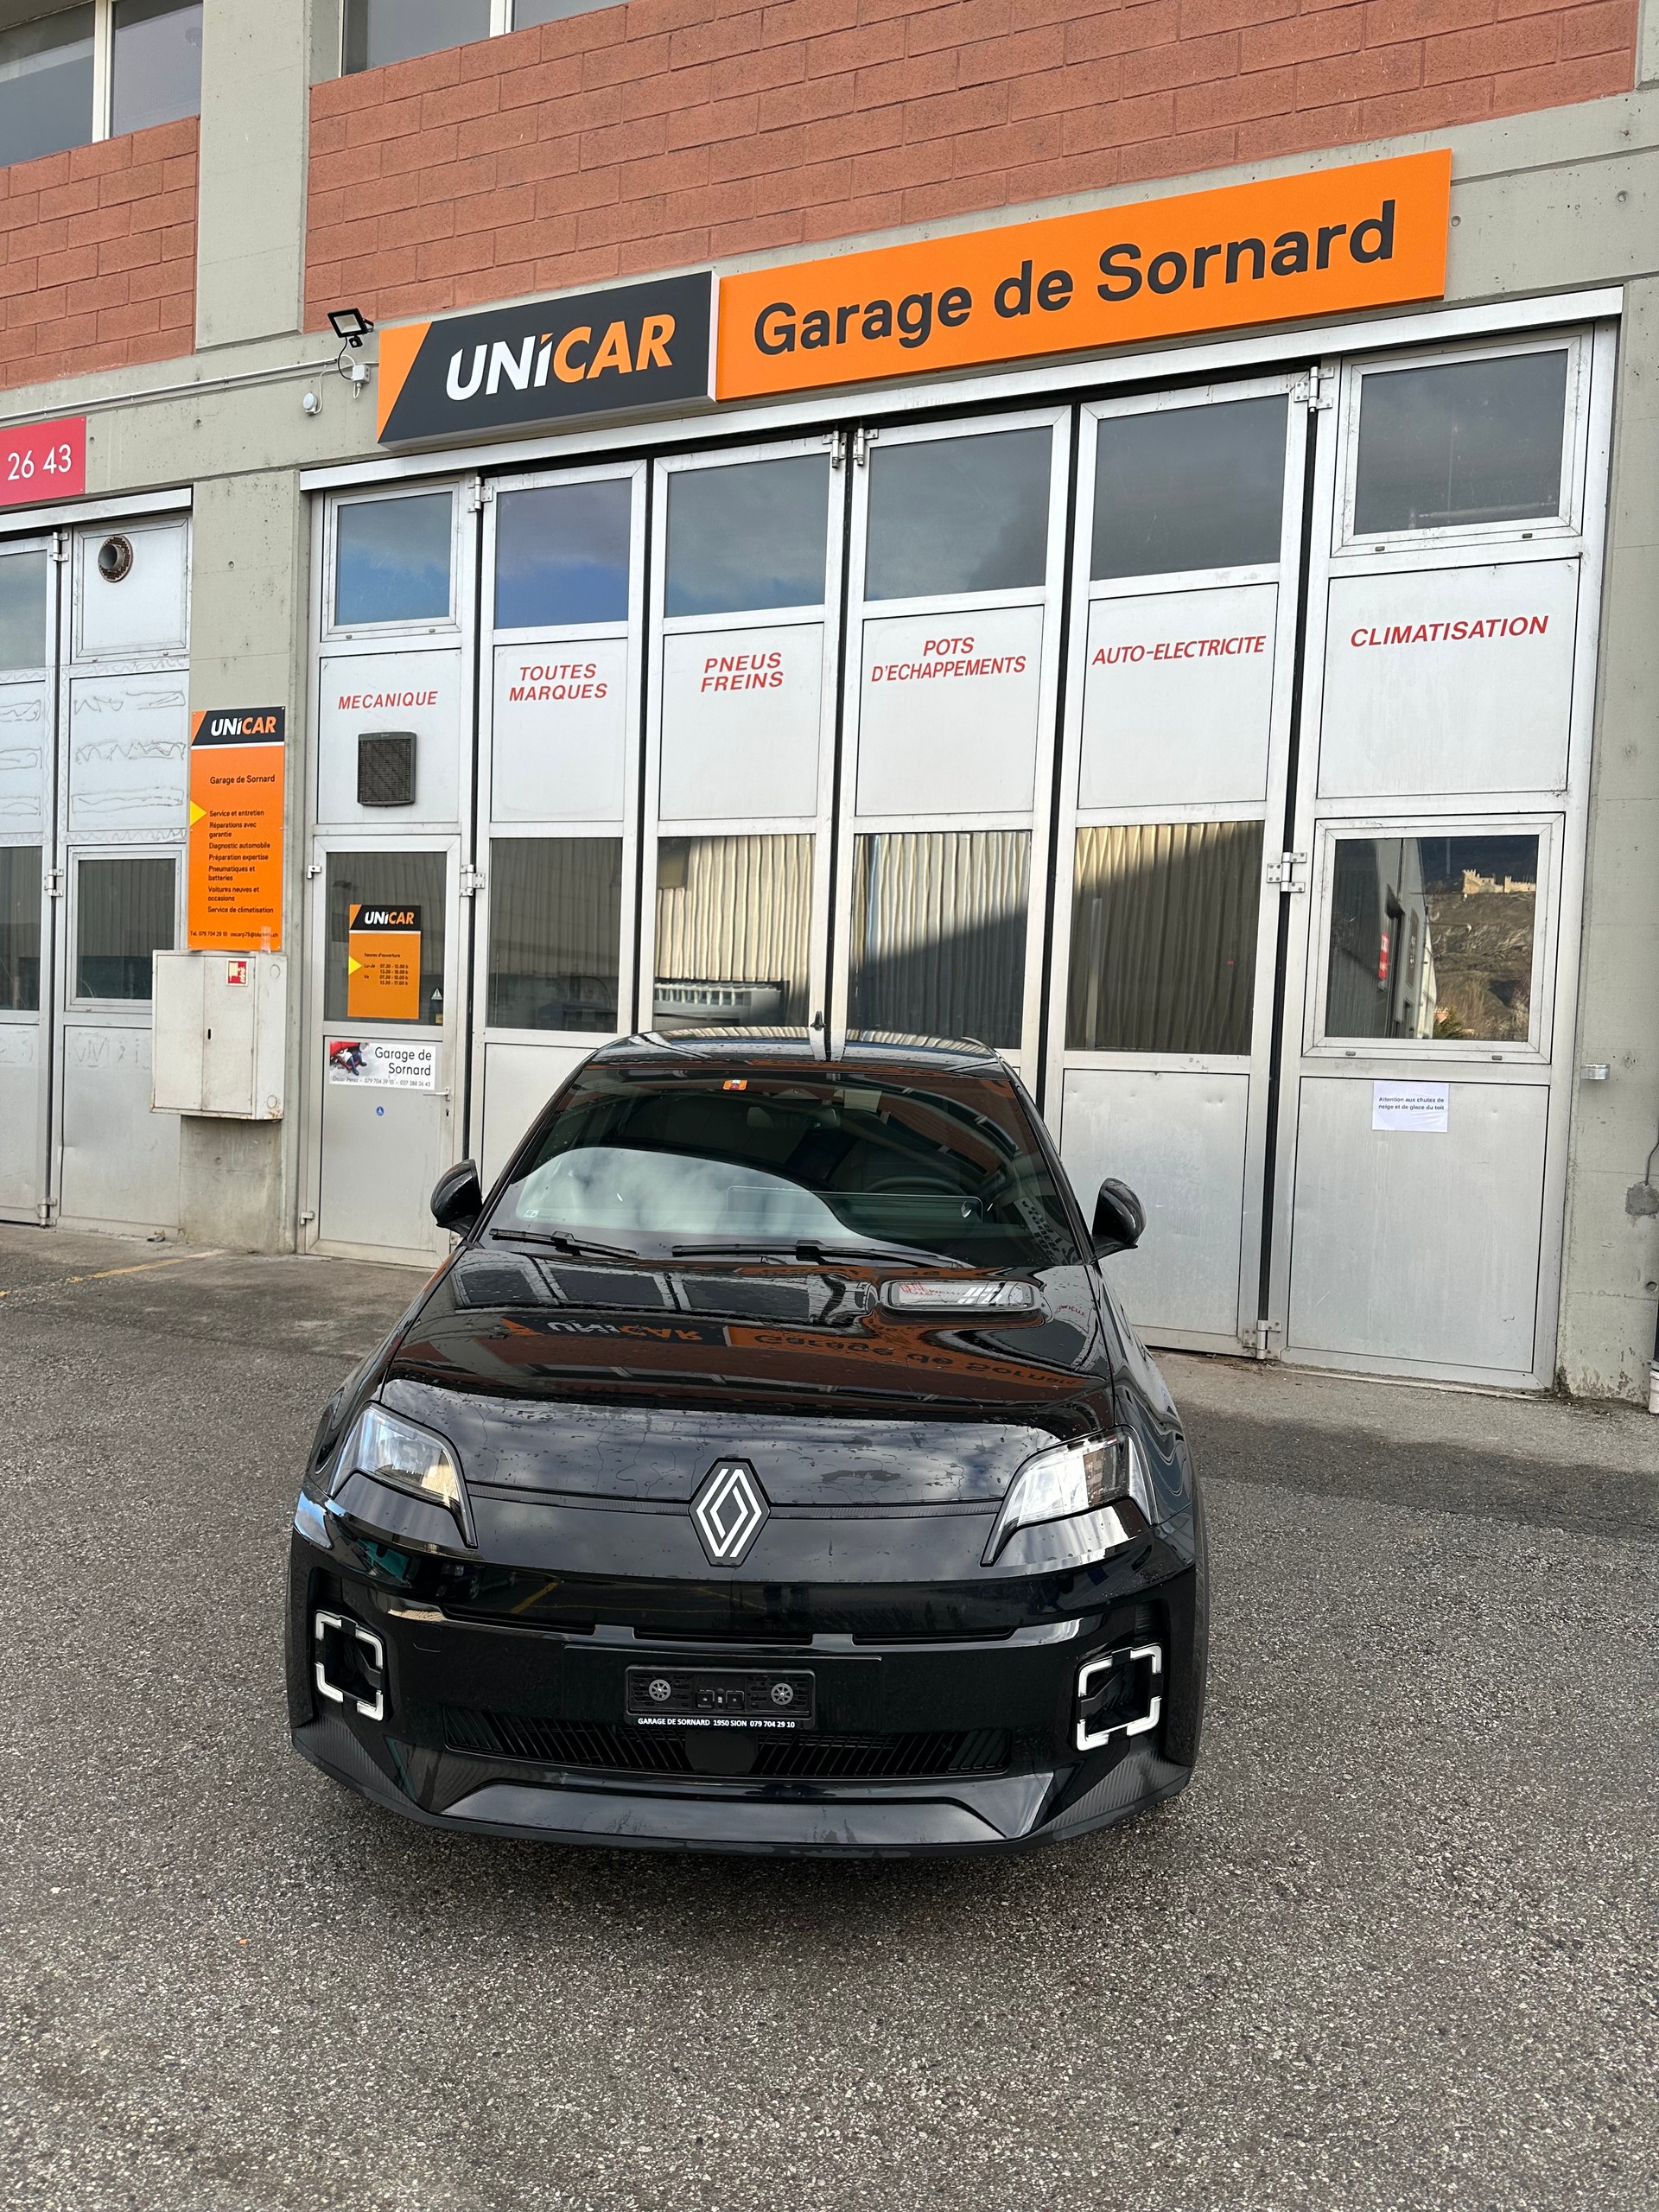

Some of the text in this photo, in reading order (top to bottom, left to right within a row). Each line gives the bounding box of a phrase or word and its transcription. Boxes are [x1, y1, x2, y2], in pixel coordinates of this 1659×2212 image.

[753, 200, 1395, 355] Garage de Sornard
[7, 443, 72, 480] 26 43
[1350, 615, 1549, 647] CLIMATISATION
[923, 636, 975, 657] POTS
[1091, 635, 1267, 665] AUTO-ELECTRICITE
[519, 663, 596, 682] TOUTES
[704, 652, 782, 674] PNEUS
[871, 655, 1027, 683] D'ECHAPPEMENTS
[509, 683, 607, 702] MARQUES
[701, 671, 784, 693] FREINS
[338, 690, 438, 710] MECANIQUE
[210, 776, 235, 785] Garage
[246, 774, 276, 783] Sornard
[374, 1046, 432, 1063] Garage de
[388, 1062, 431, 1076] Sornard
[638, 1717, 666, 1726] GARAGE
[677, 1718, 710, 1726] SORNARD
